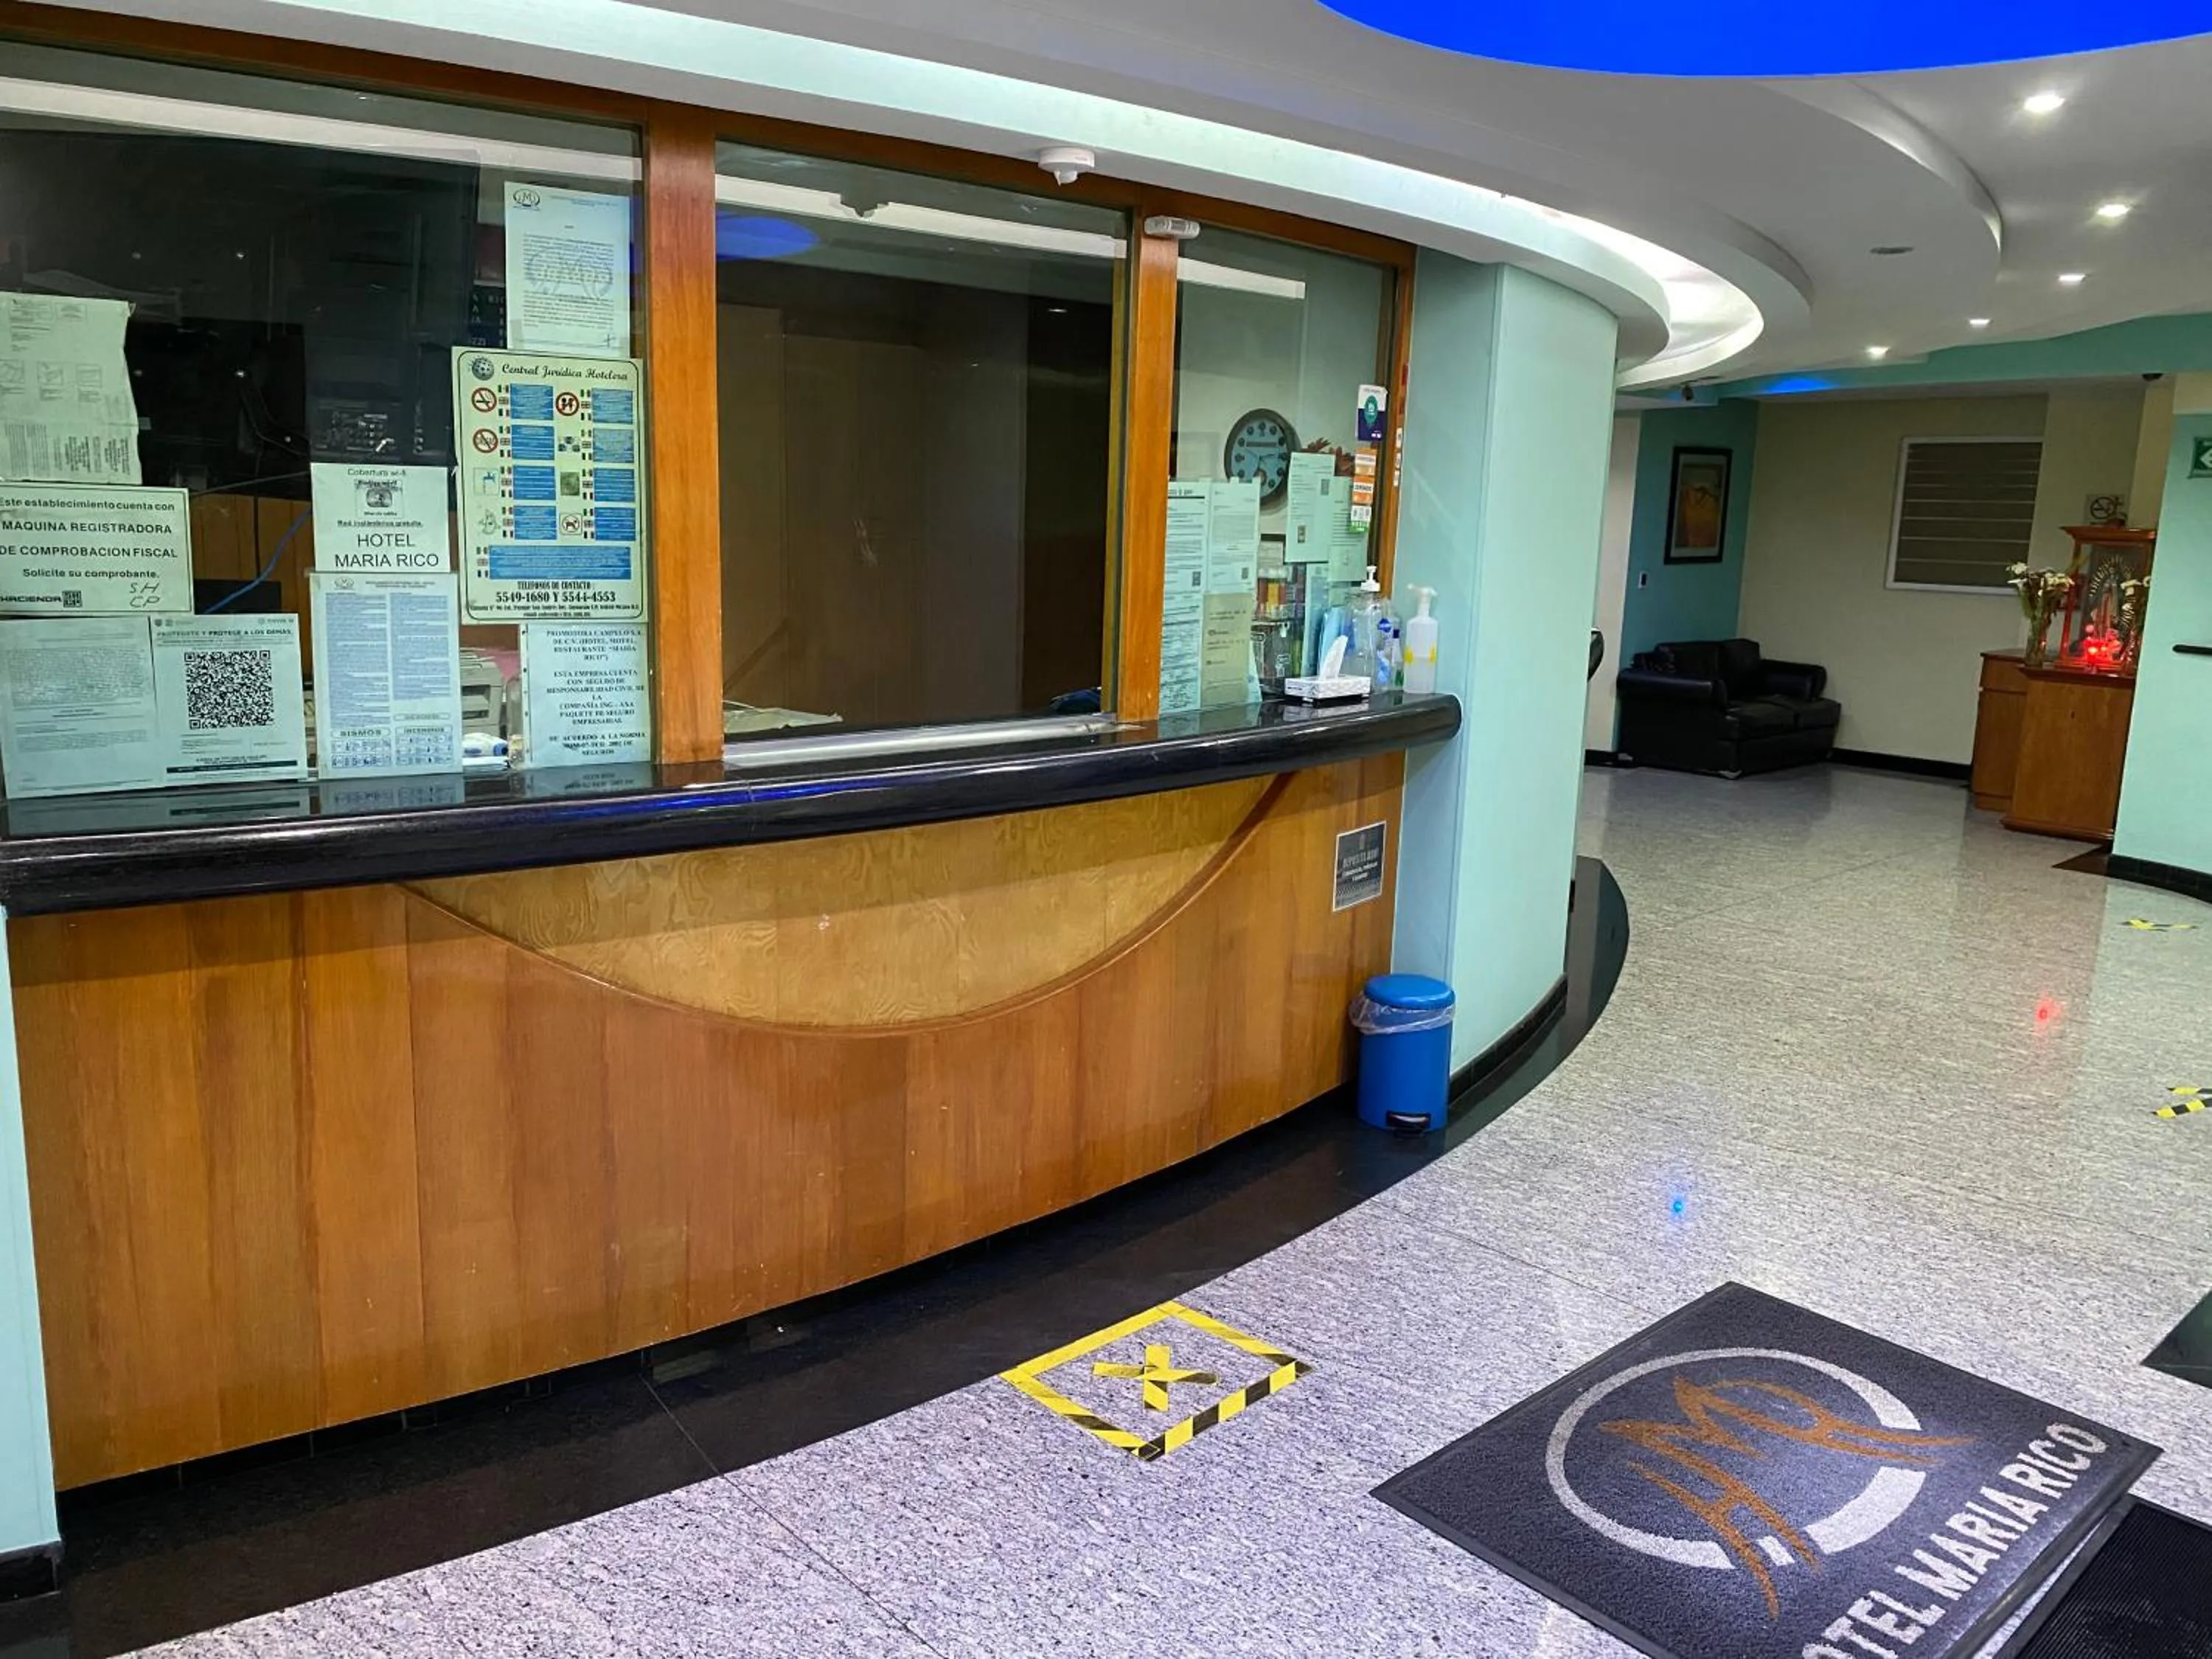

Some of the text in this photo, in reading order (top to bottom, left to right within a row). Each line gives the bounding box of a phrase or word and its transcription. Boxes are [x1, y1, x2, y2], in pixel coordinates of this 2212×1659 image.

[502, 364, 628, 380] Central Jurídica Hotelera
[0, 498, 175, 511] Este establecimiento cuenta con
[2, 521, 172, 534] MAQUINA REGISTRADORA
[357, 533, 417, 548] HOTEL
[0, 546, 178, 558] DE COMPROBACION FISCAL
[335, 553, 439, 567] MARIA RICO
[23, 568, 66, 577] Solicite
[85, 570, 160, 580] comprobante.
[495, 591, 616, 602] 5549-1680 Y 5544-4553
[546, 686, 614, 694] RESPONSABILIDAD
[1894, 1485, 2051, 1601] MARIA
[1999, 1422, 2110, 1500] RICO
